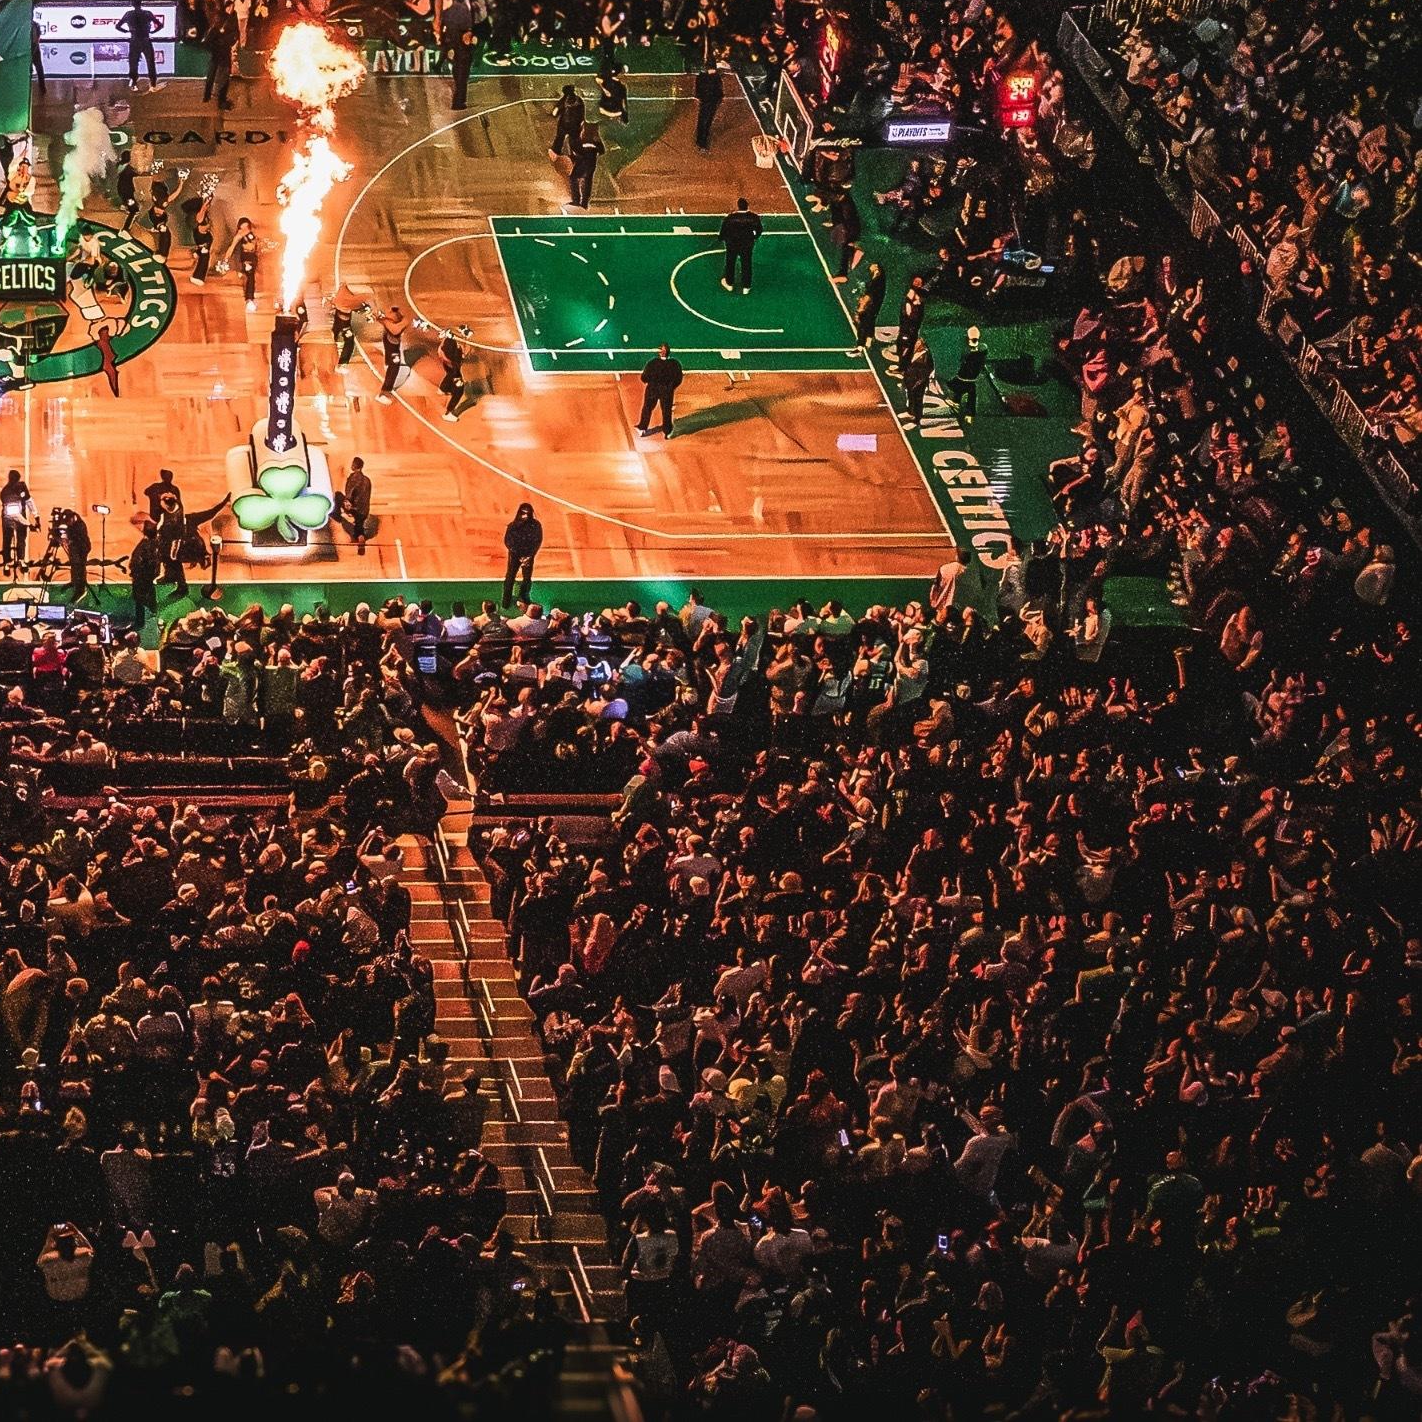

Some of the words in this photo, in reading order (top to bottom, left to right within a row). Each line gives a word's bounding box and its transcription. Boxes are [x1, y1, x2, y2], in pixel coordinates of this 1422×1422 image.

[72, 17, 86, 26] abc
[482, 48, 594, 70] Google
[1010, 88, 1028, 100] 24
[143, 130, 286, 145] GARD
[93, 231, 168, 329] CELTICS
